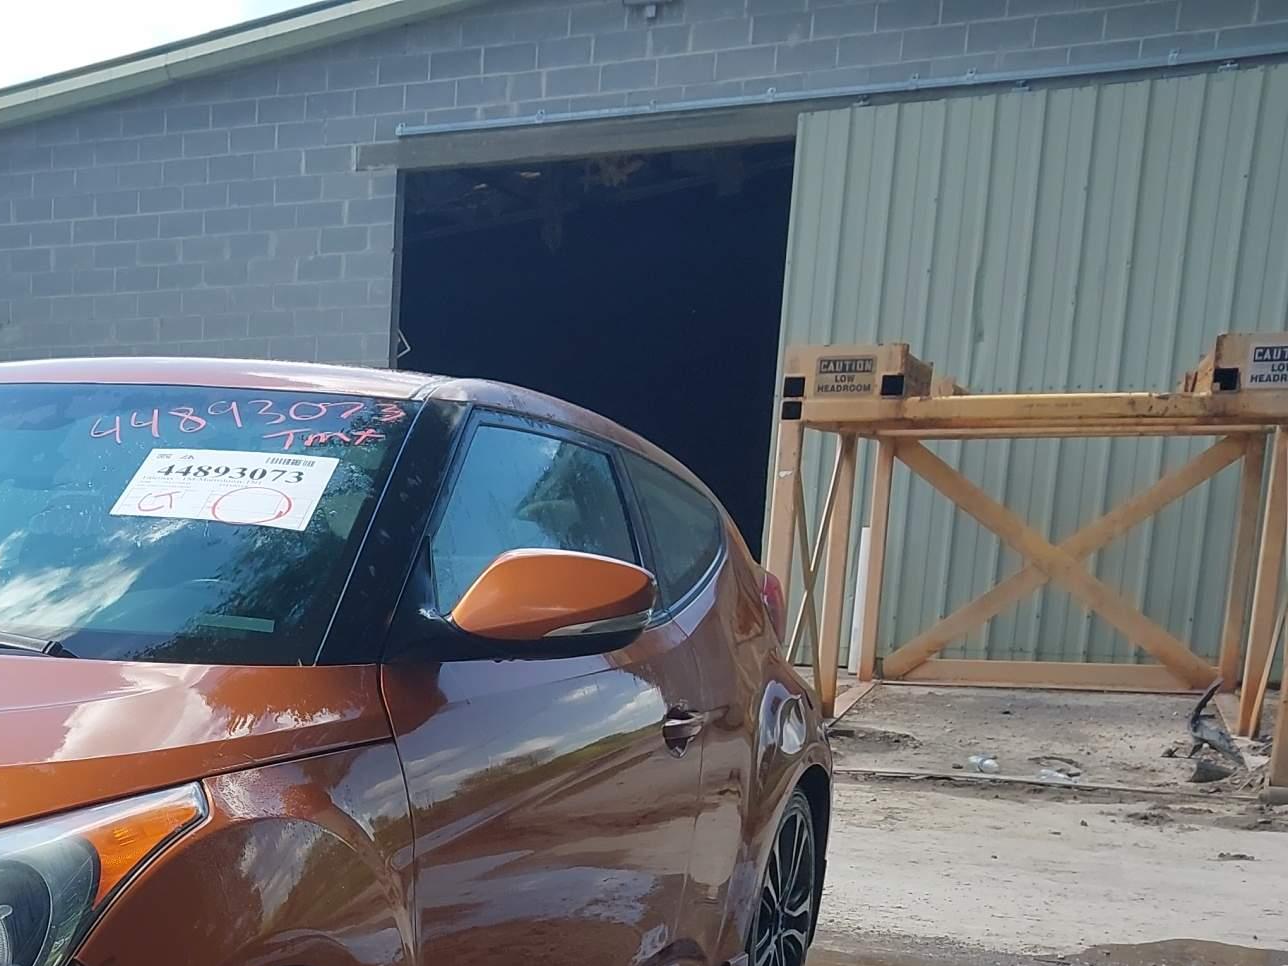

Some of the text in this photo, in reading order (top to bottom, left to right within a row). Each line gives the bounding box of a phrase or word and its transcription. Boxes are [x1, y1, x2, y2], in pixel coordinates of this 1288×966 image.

[820, 360, 873, 373] CAUTION
[834, 374, 856, 384] LOW
[817, 383, 871, 393] HEADROOM
[90, 399, 406, 444] 44893073
[157, 464, 305, 484] 44893073
